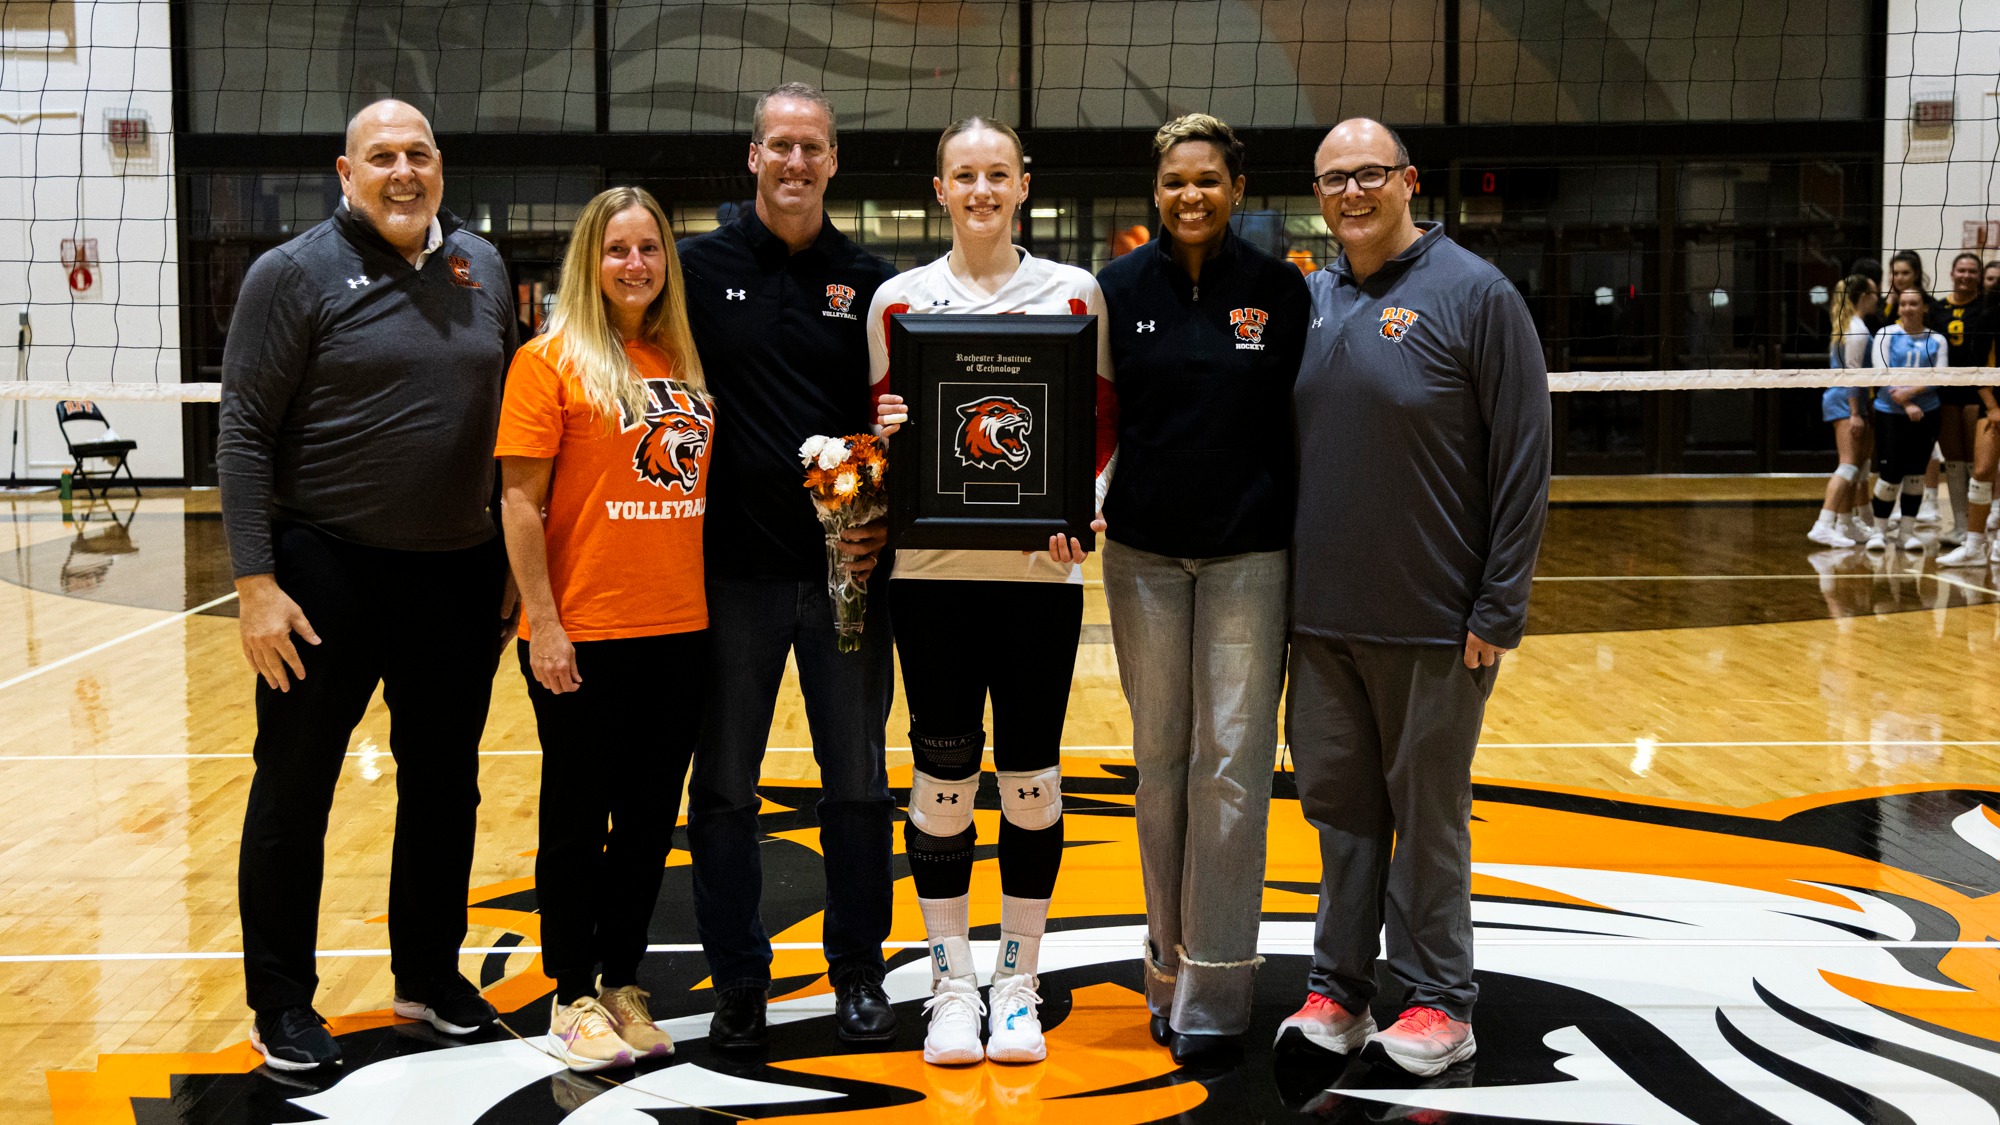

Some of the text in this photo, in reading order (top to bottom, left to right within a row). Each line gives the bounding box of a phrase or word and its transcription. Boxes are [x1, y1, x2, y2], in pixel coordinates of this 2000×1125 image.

[826, 284, 856, 300] RIT
[822, 310, 858, 320] VOLLEYBALL
[1230, 307, 1269, 325] RIT
[1380, 307, 1419, 326] RIT
[1947, 320, 1965, 347] 9
[1235, 343, 1265, 351] HOCKEY
[956, 353, 1031, 363] Rochester Institute
[966, 364, 1020, 374] of Technology
[64, 400, 93, 416] RIT
